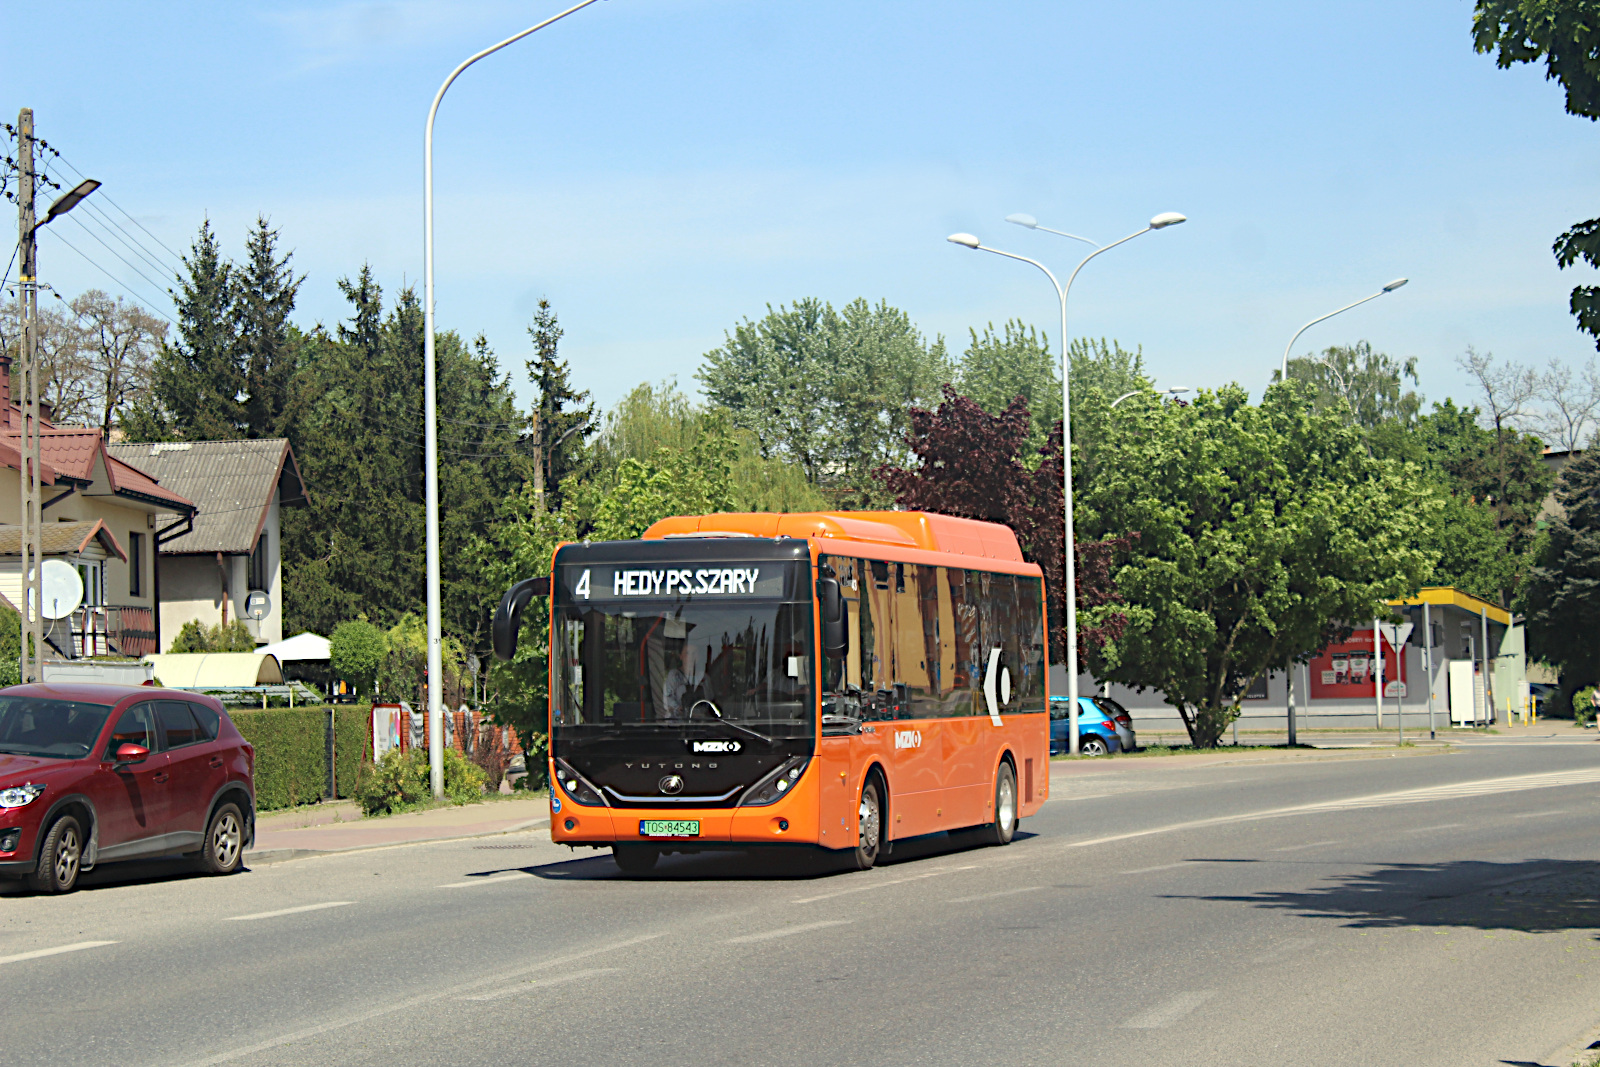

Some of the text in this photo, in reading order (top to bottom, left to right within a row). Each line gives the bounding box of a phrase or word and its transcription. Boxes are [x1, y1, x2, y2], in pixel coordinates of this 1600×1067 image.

[575, 569, 591, 600] 4
[694, 741, 730, 752] MZK
[646, 822, 698, 833] TOS 84543
